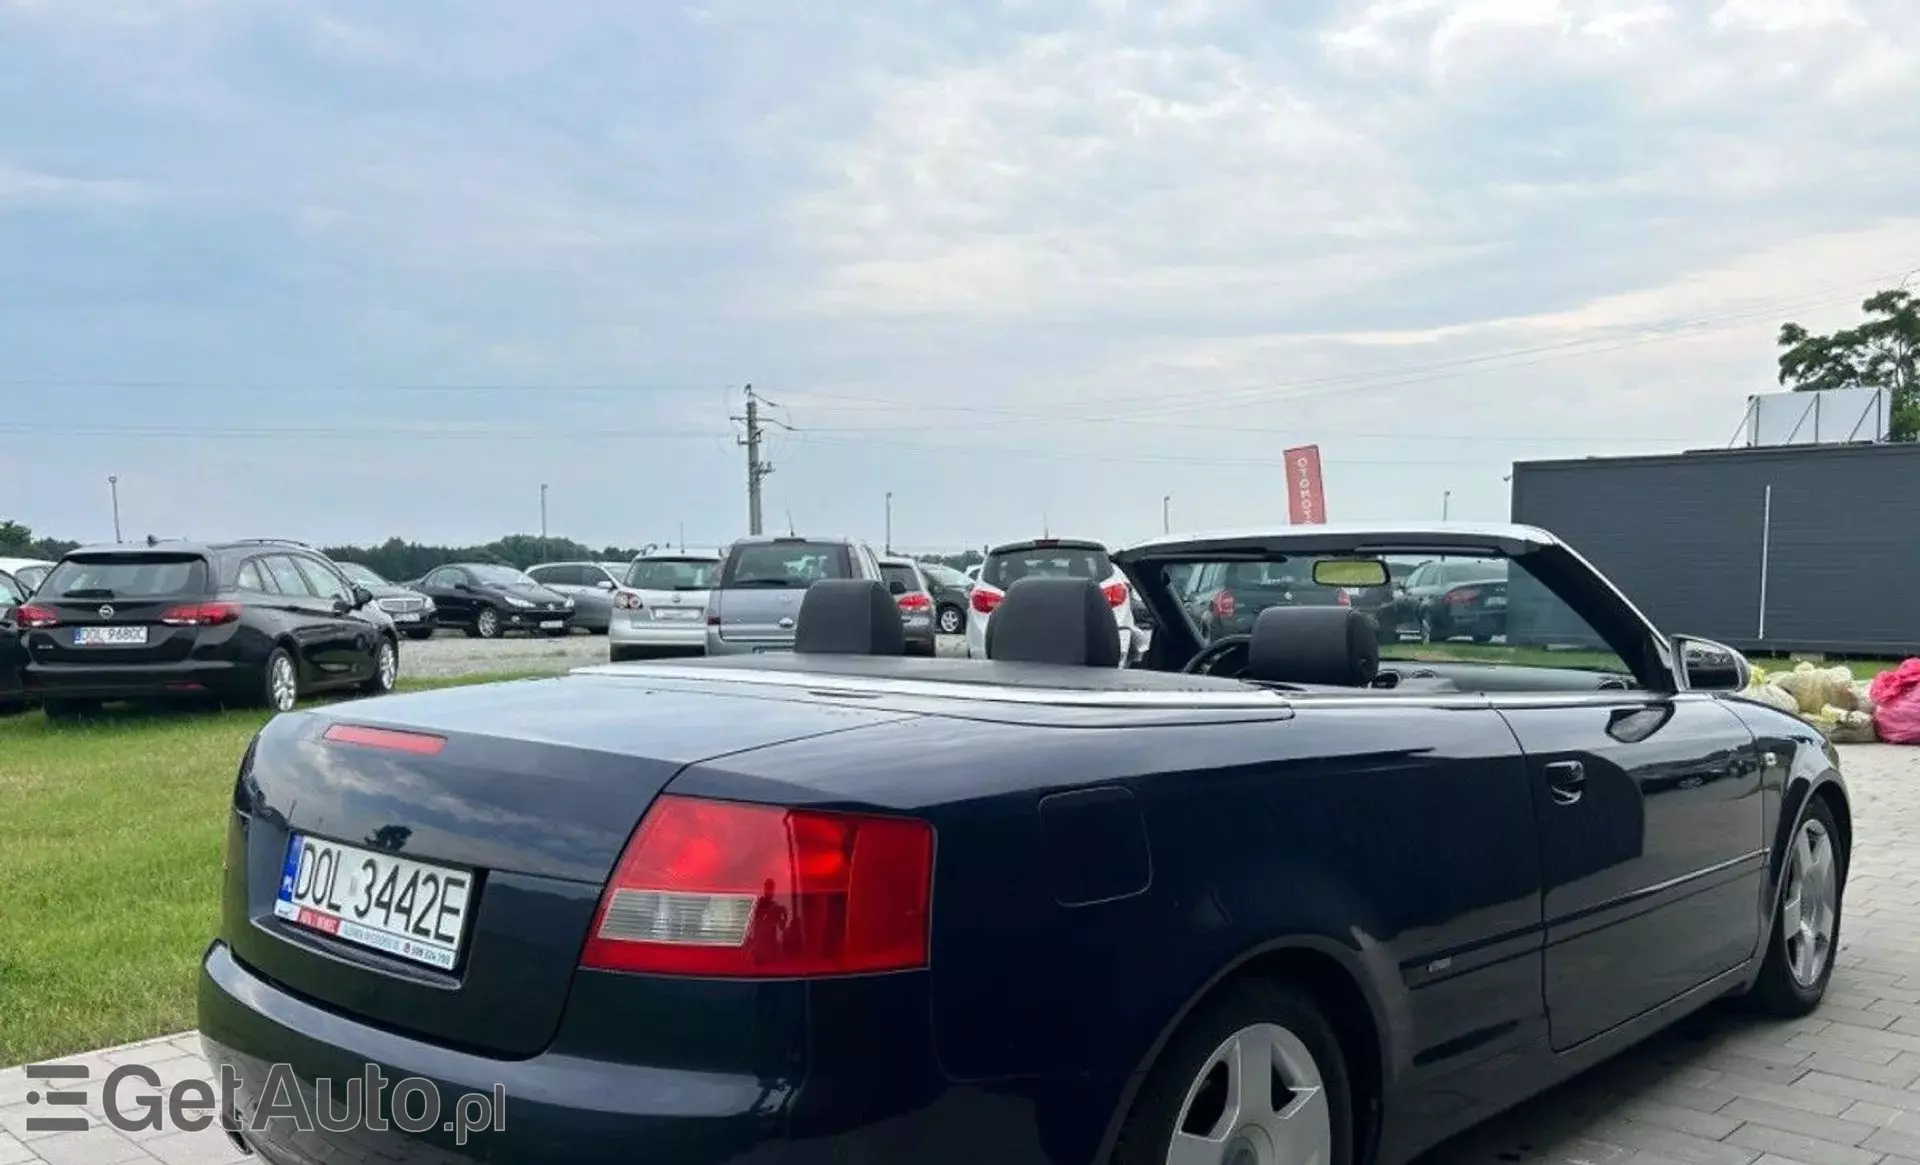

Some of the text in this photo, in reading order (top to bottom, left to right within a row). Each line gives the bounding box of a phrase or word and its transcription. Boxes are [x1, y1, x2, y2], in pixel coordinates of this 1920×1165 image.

[1297, 457, 1313, 522] OTOMOT
[294, 842, 466, 944] DOL 3442E
